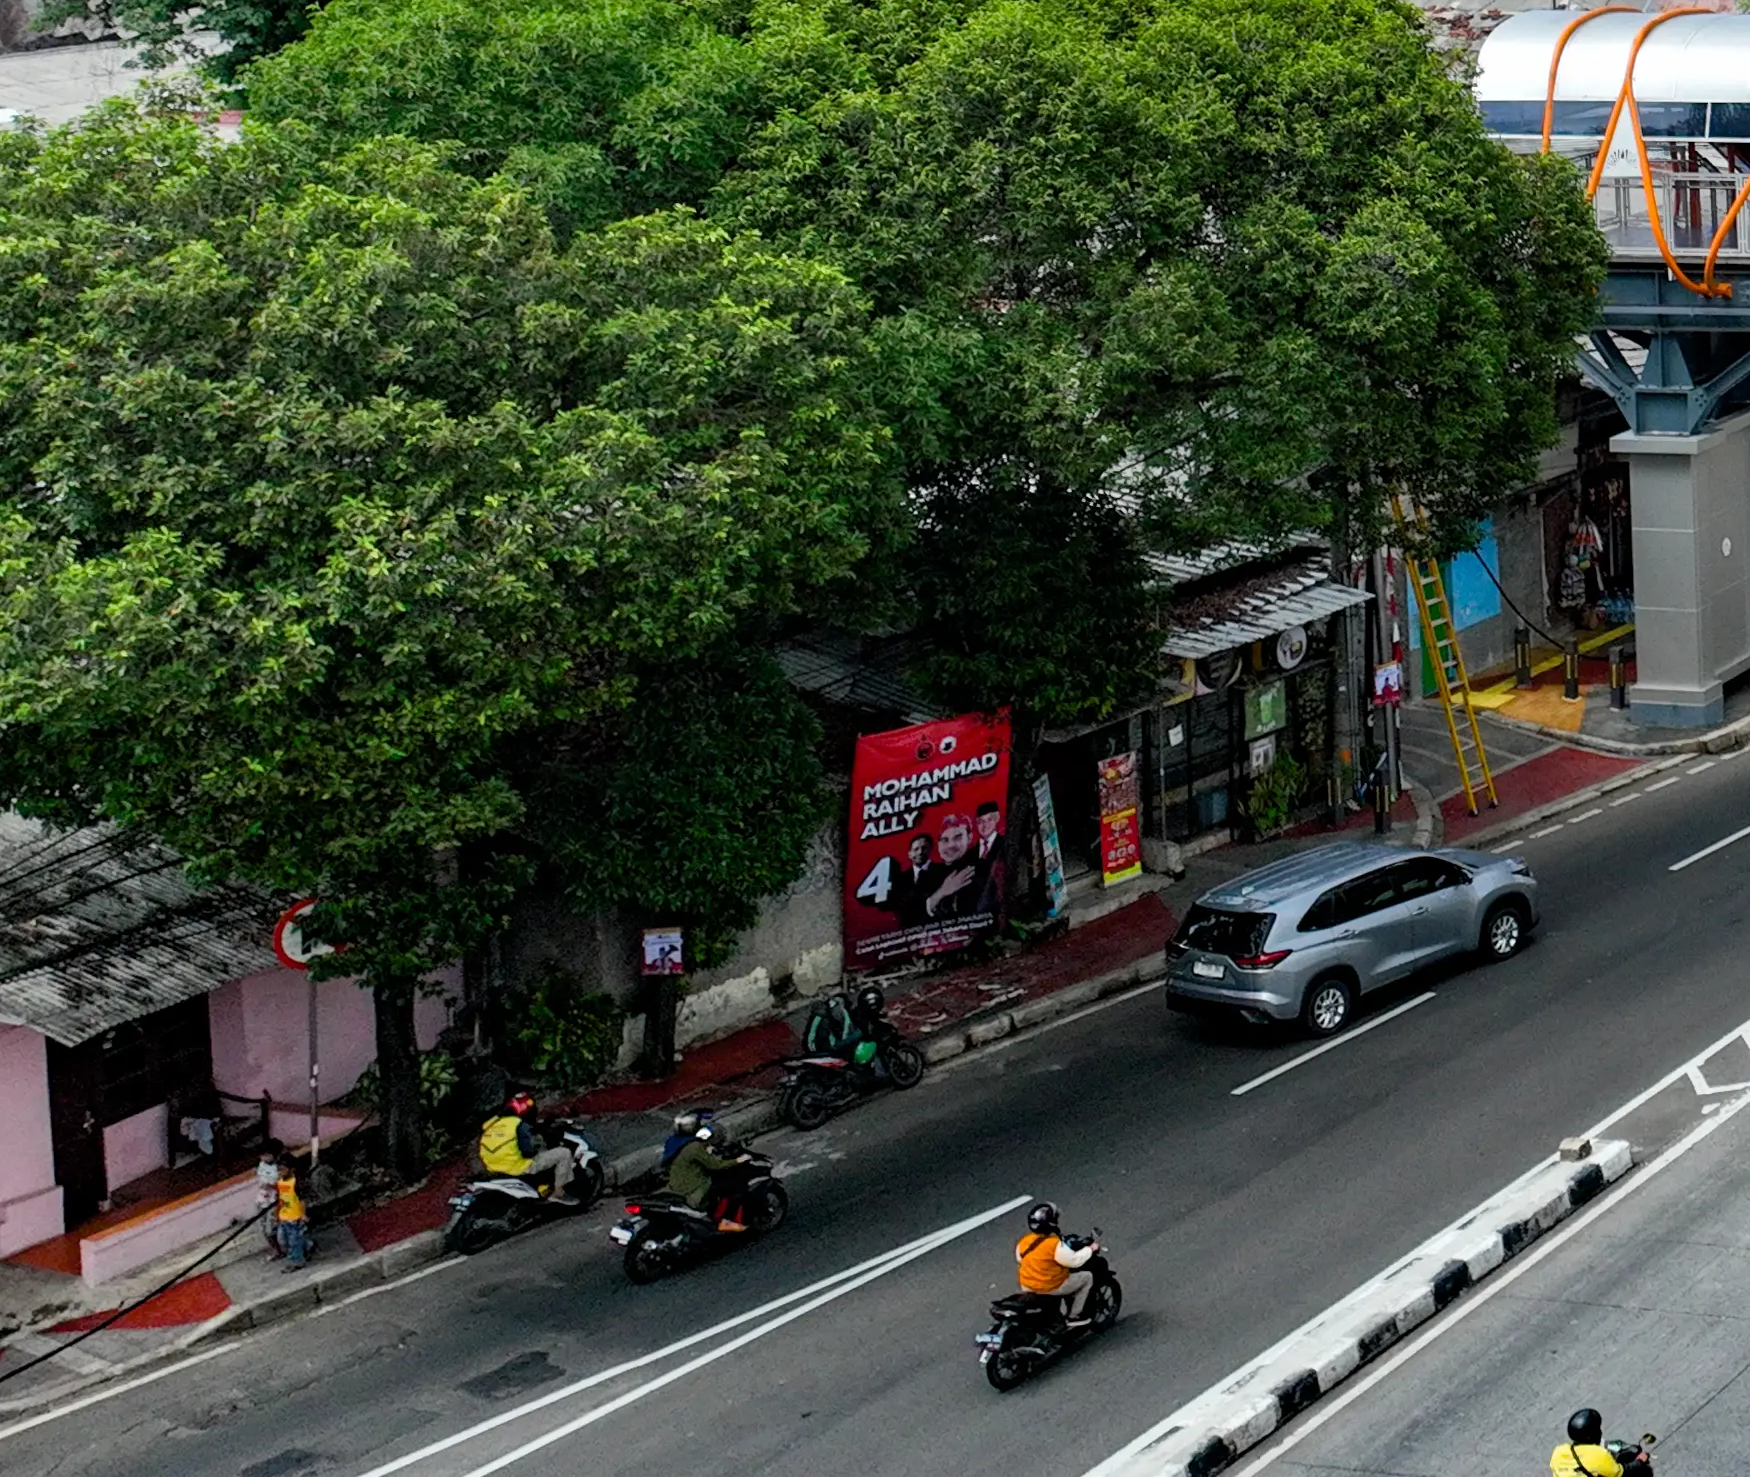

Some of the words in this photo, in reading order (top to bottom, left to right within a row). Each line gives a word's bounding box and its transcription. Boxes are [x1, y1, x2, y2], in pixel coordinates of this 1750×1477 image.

[864, 752, 998, 801] MOHAMMAD
[863, 783, 950, 820] RAIHAN
[860, 810, 919, 840] ALLY
[856, 855, 893, 903] 4
